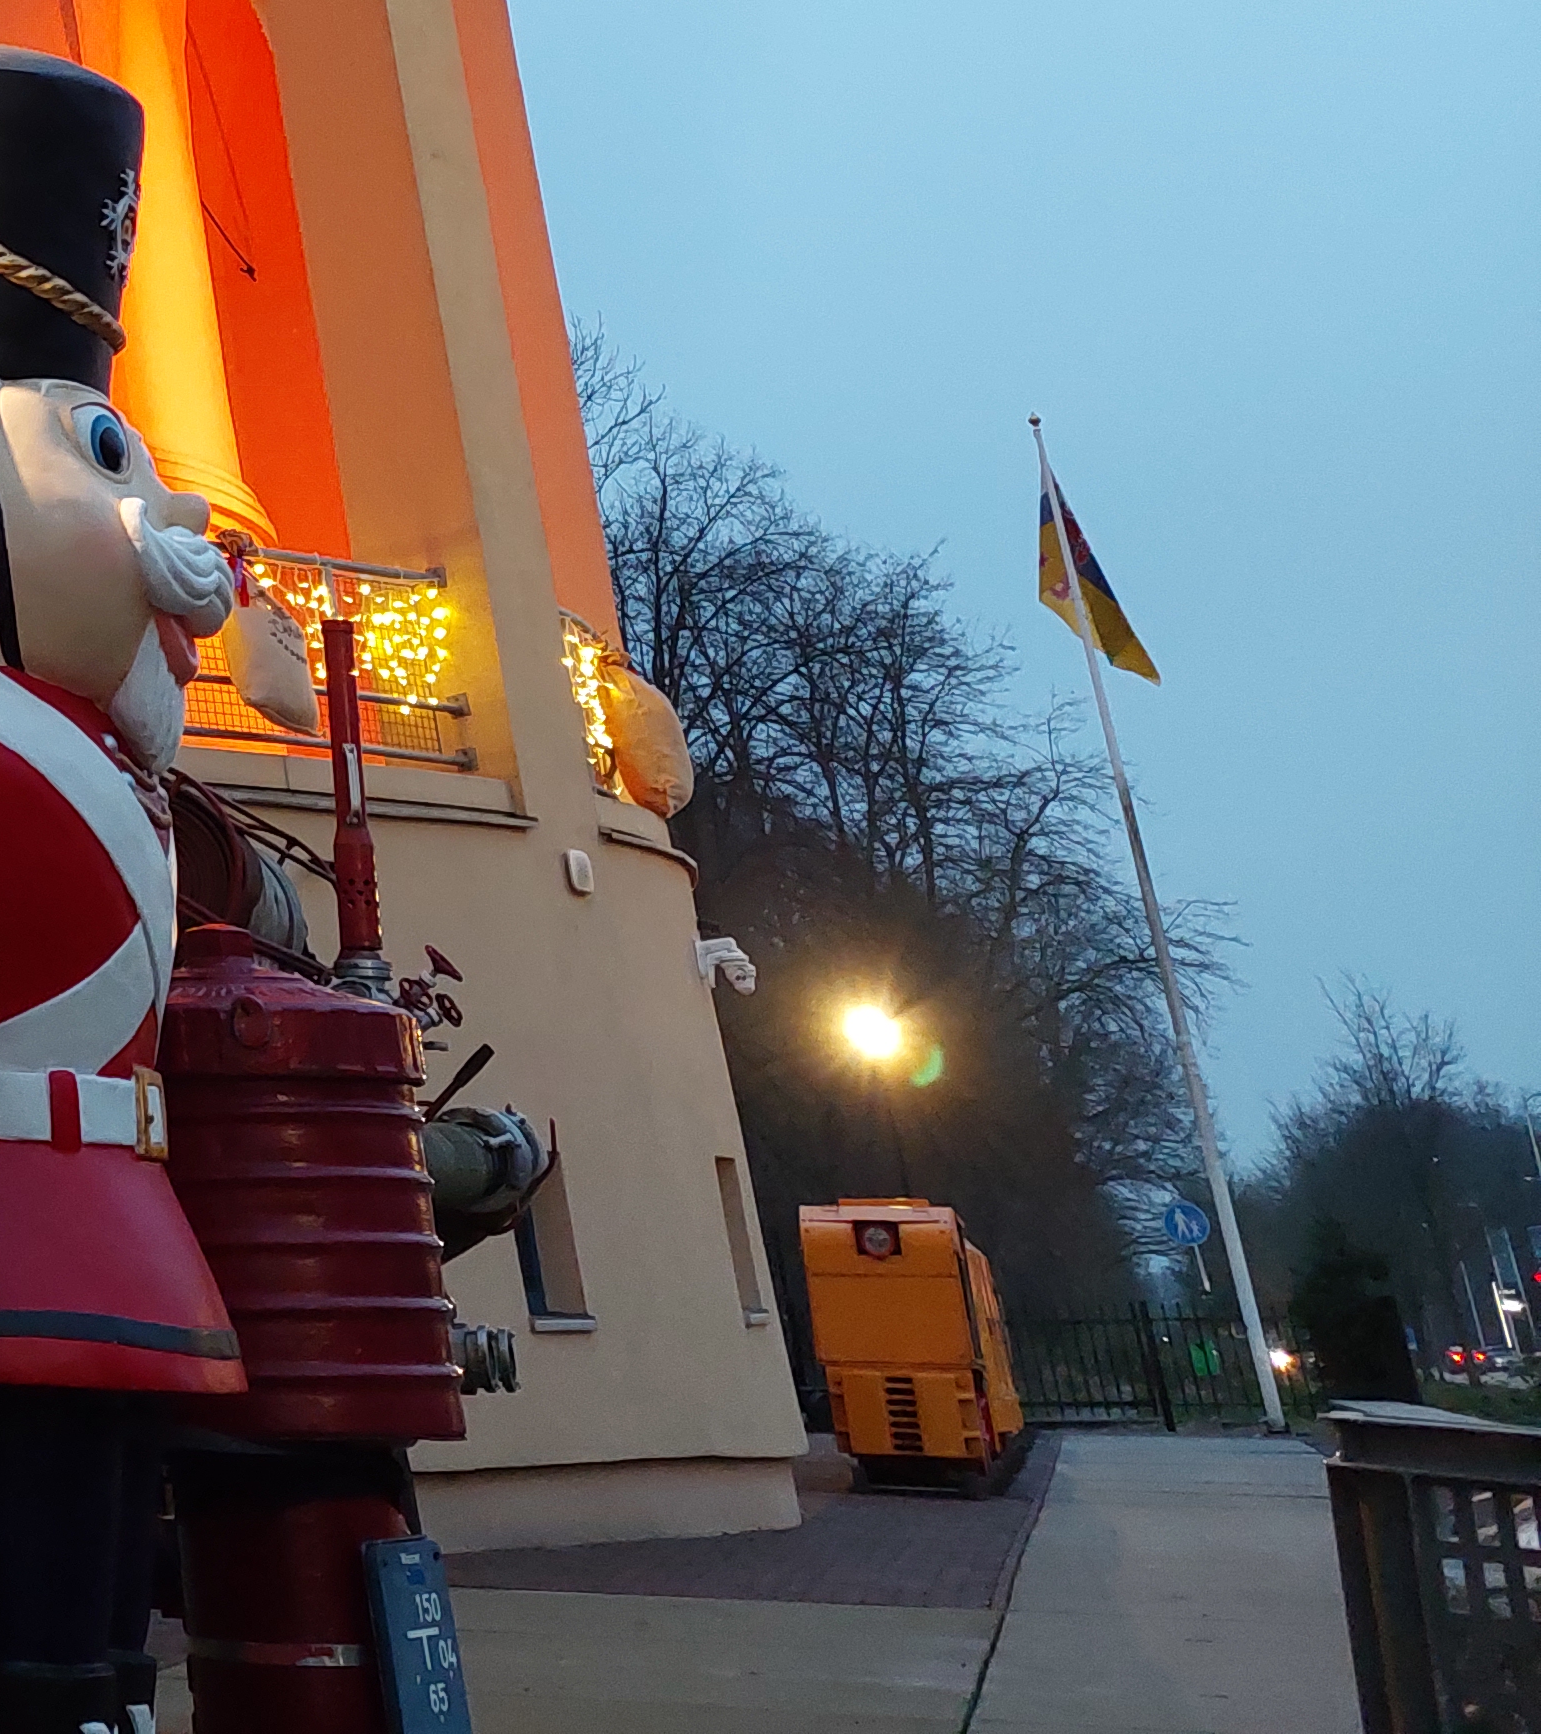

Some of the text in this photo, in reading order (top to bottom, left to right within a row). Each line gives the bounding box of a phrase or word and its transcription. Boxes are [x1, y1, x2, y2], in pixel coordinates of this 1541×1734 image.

[415, 1592, 441, 1622] 150
[438, 1638, 457, 1669] 04
[429, 1682, 449, 1713] 65
